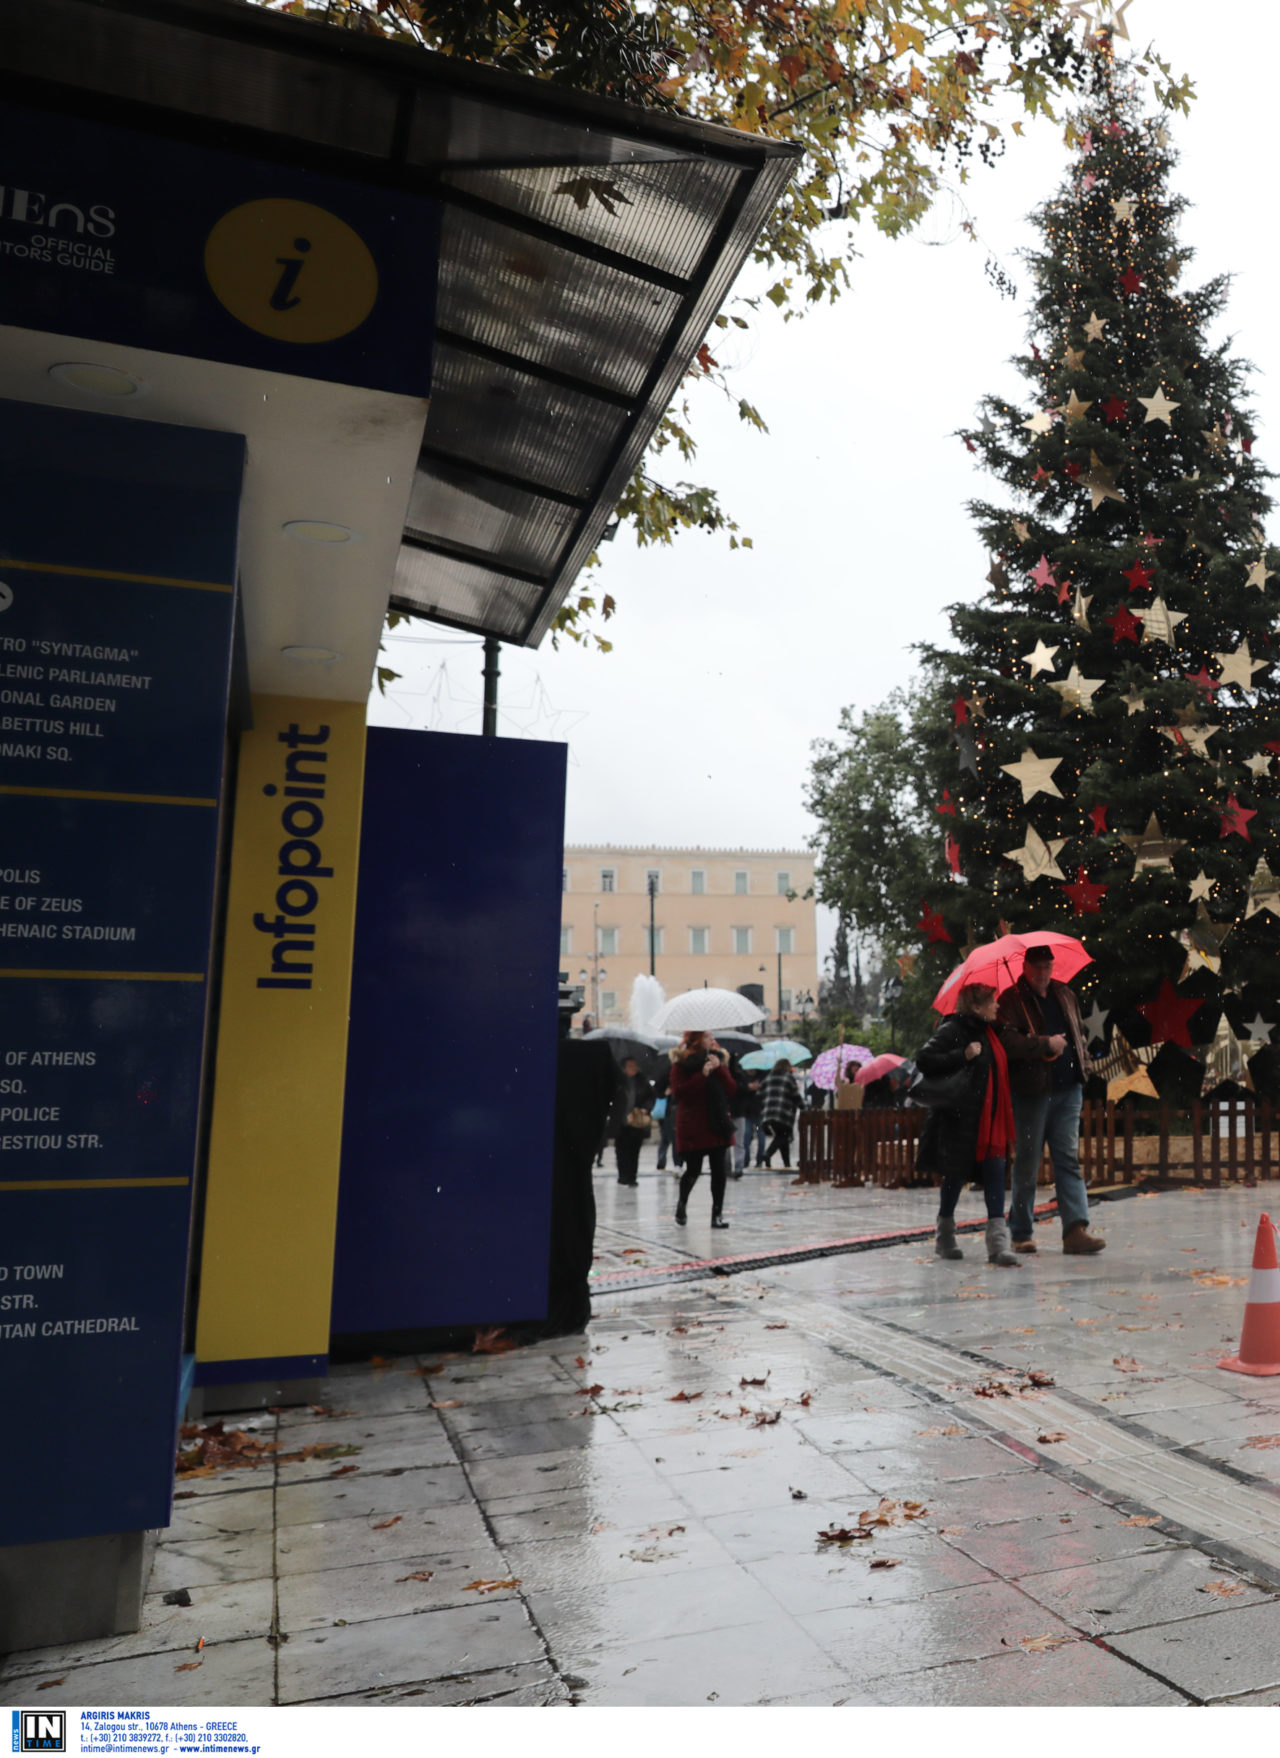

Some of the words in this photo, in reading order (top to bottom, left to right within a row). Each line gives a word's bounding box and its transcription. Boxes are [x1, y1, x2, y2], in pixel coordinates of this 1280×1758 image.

[31, 234, 116, 262] OFFICIAL
[56, 252, 115, 275] GUIDE
[32, 640, 139, 662] "SYNTAGMA"
[49, 667, 152, 690] PARLIAMENT
[0, 690, 45, 706] ONAL
[50, 694, 117, 713] GARDEN
[0, 716, 65, 735] BETTUS
[69, 721, 104, 738] HILL
[0, 743, 41, 759] NAKI
[46, 746, 73, 762] SQ.
[253, 723, 335, 989] Infopoint
[15, 896, 37, 911] OF
[41, 897, 83, 913] ZEUS
[62, 925, 136, 941] STADIUM
[5, 1051, 28, 1066] OF
[30, 1051, 96, 1066] ATHENS
[0, 1079, 27, 1095] SQ.
[0, 1107, 61, 1122] POLICE
[0, 1135, 62, 1150] ESTIOU
[66, 1134, 104, 1149] STR.
[13, 1264, 64, 1281] TOWN
[0, 1294, 39, 1310] STR.
[41, 1316, 140, 1337] CATHEDRAL
